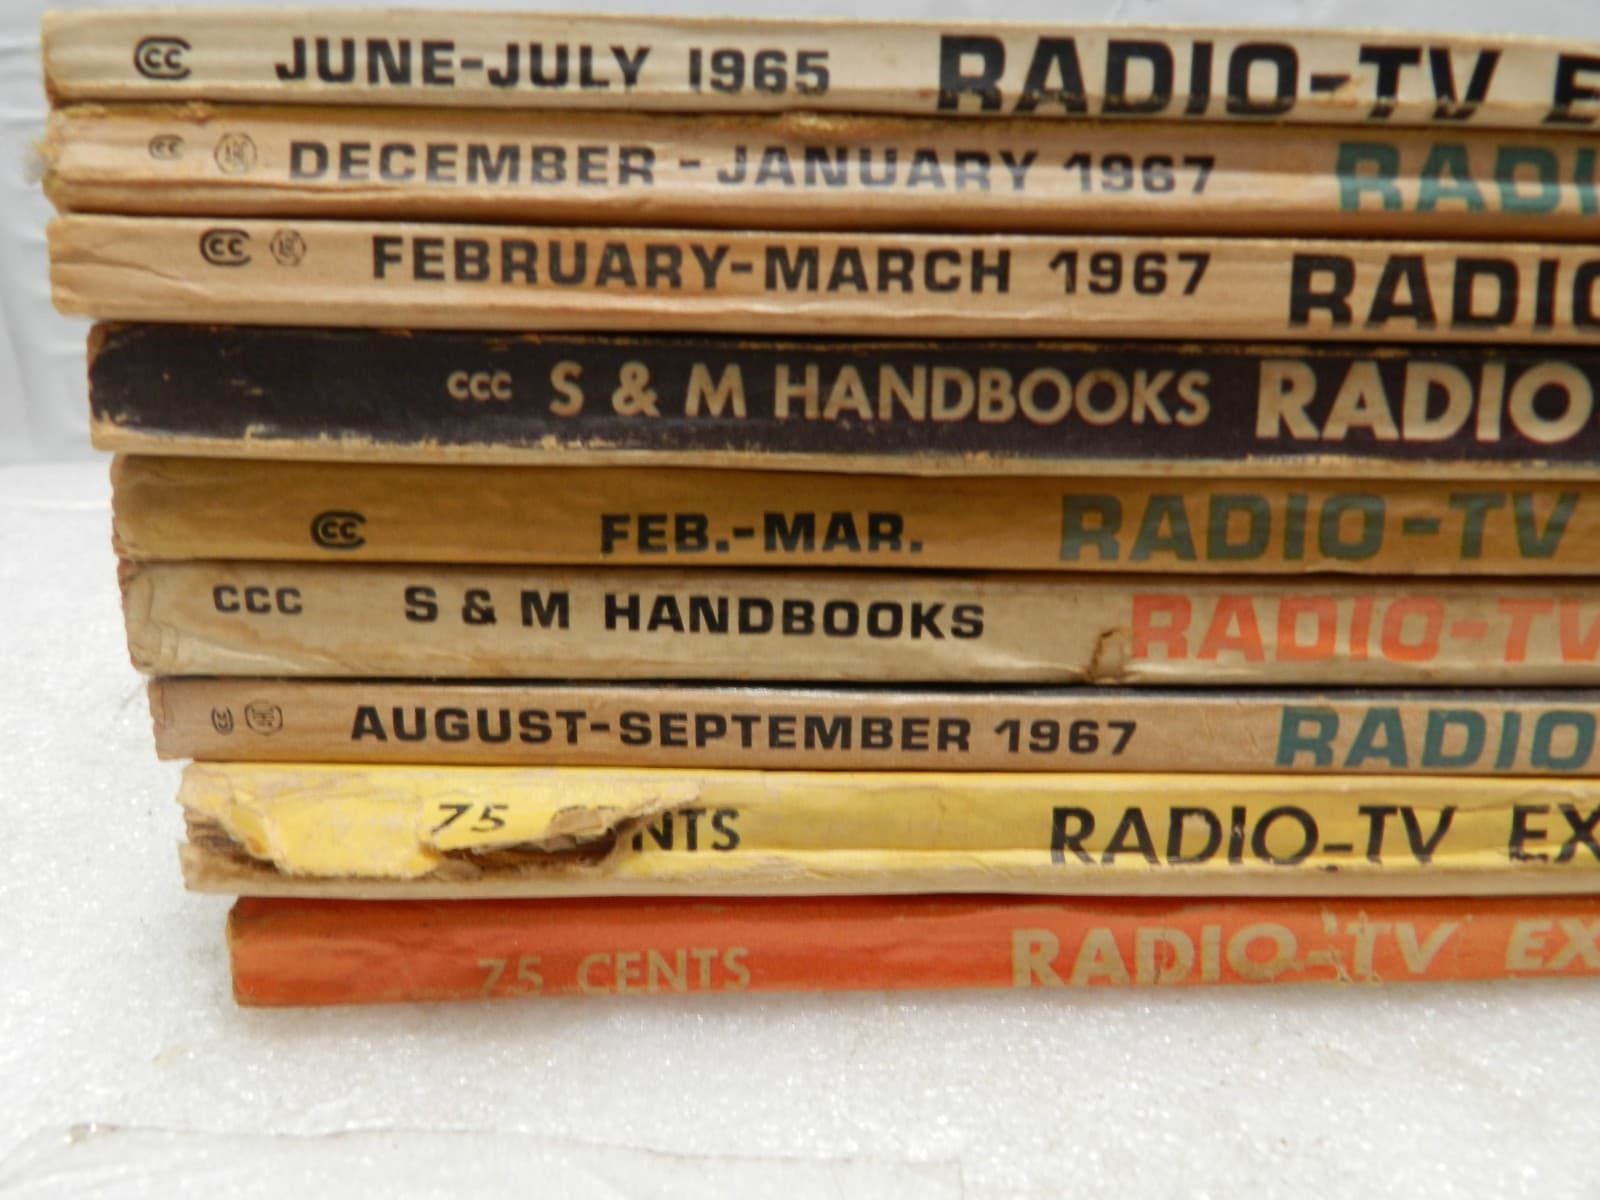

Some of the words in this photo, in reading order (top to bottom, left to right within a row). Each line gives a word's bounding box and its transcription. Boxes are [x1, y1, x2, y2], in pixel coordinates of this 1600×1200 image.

[275, 36, 651, 89] JUNE-JULY
[689, 47, 830, 96] 1965
[936, 33, 1501, 121] RADIO-TV
[289, 140, 657, 188] DECEMBER
[717, 145, 1039, 193] JANUARY
[1063, 153, 1217, 194] 1967
[371, 234, 1012, 297] FEBRUARY-MARCH
[1050, 250, 1212, 297] 1967
[549, 361, 584, 418] S
[611, 364, 660, 417] &
[684, 363, 746, 419] M
[775, 364, 1211, 427] HANDBOOKS
[1255, 359, 1594, 444] RADIO
[601, 511, 923, 556] FEB.-MAR.
[1060, 492, 1580, 562] RADIO-TV
[213, 584, 304, 615] CCC
[403, 584, 439, 625] S
[462, 587, 498, 626] &
[520, 589, 572, 630] M
[604, 593, 986, 641] HANDBOOKS
[351, 704, 972, 756] AUGUST-SEPTEMBER
[995, 717, 1139, 756] 1967
[1274, 704, 1596, 771] RADIO
[431, 803, 509, 833] 75
[1049, 804, 1458, 867] RADIO-TV
[476, 954, 544, 999] 75
[576, 946, 752, 997] CENTS
[1011, 919, 1460, 987] RADIO-TV
